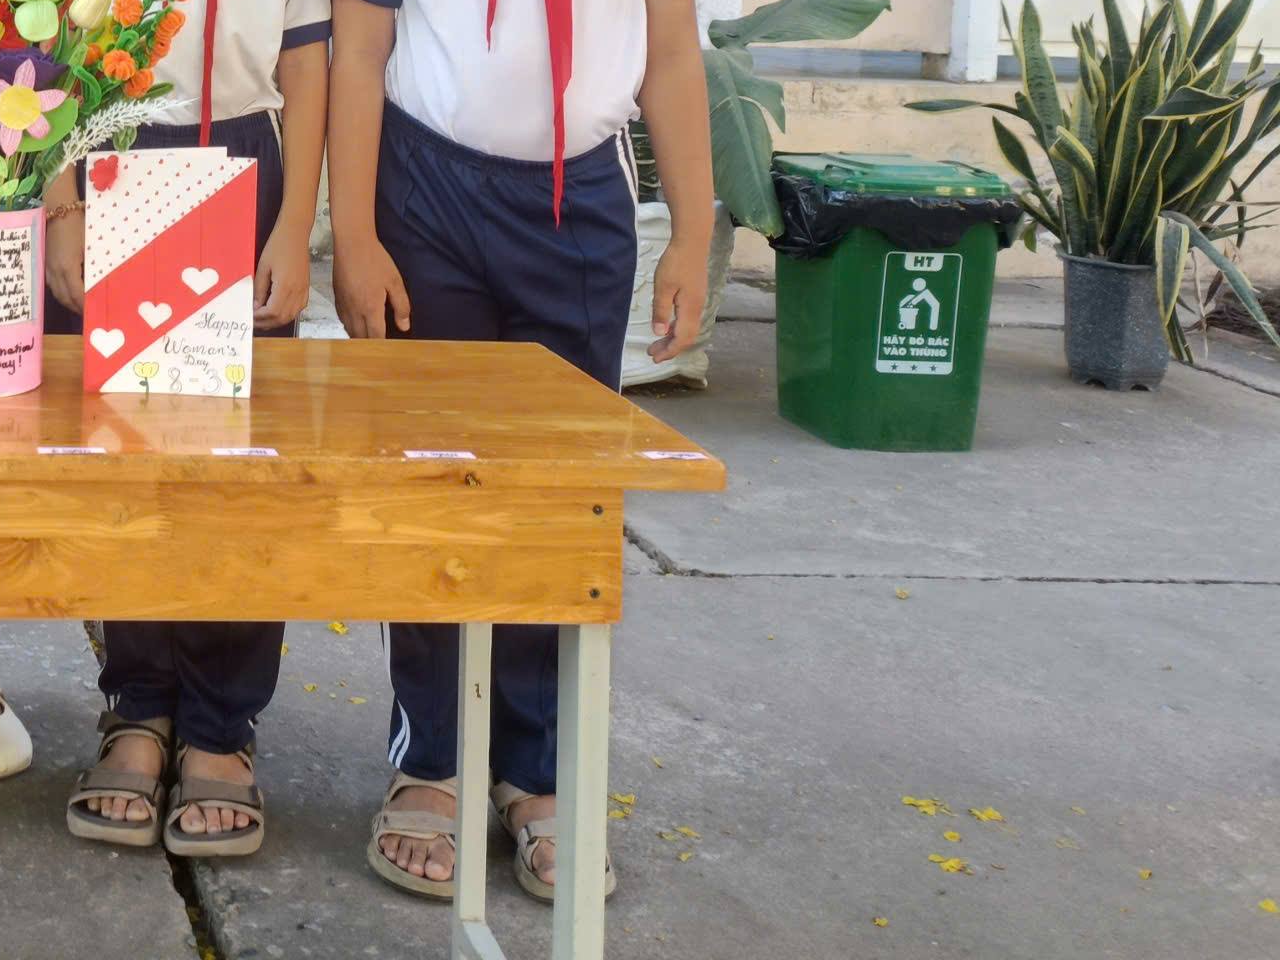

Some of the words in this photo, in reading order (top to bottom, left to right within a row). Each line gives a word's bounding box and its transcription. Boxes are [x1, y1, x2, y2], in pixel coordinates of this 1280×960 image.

[913, 256, 934, 267] HT
[195, 312, 250, 341] Happy
[883, 334, 906, 345] HÃY
[909, 333, 924, 345] BỎ
[927, 336, 949, 346] RÁC
[883, 345, 907, 356] VÀO
[910, 347, 947, 357] THÙNG
